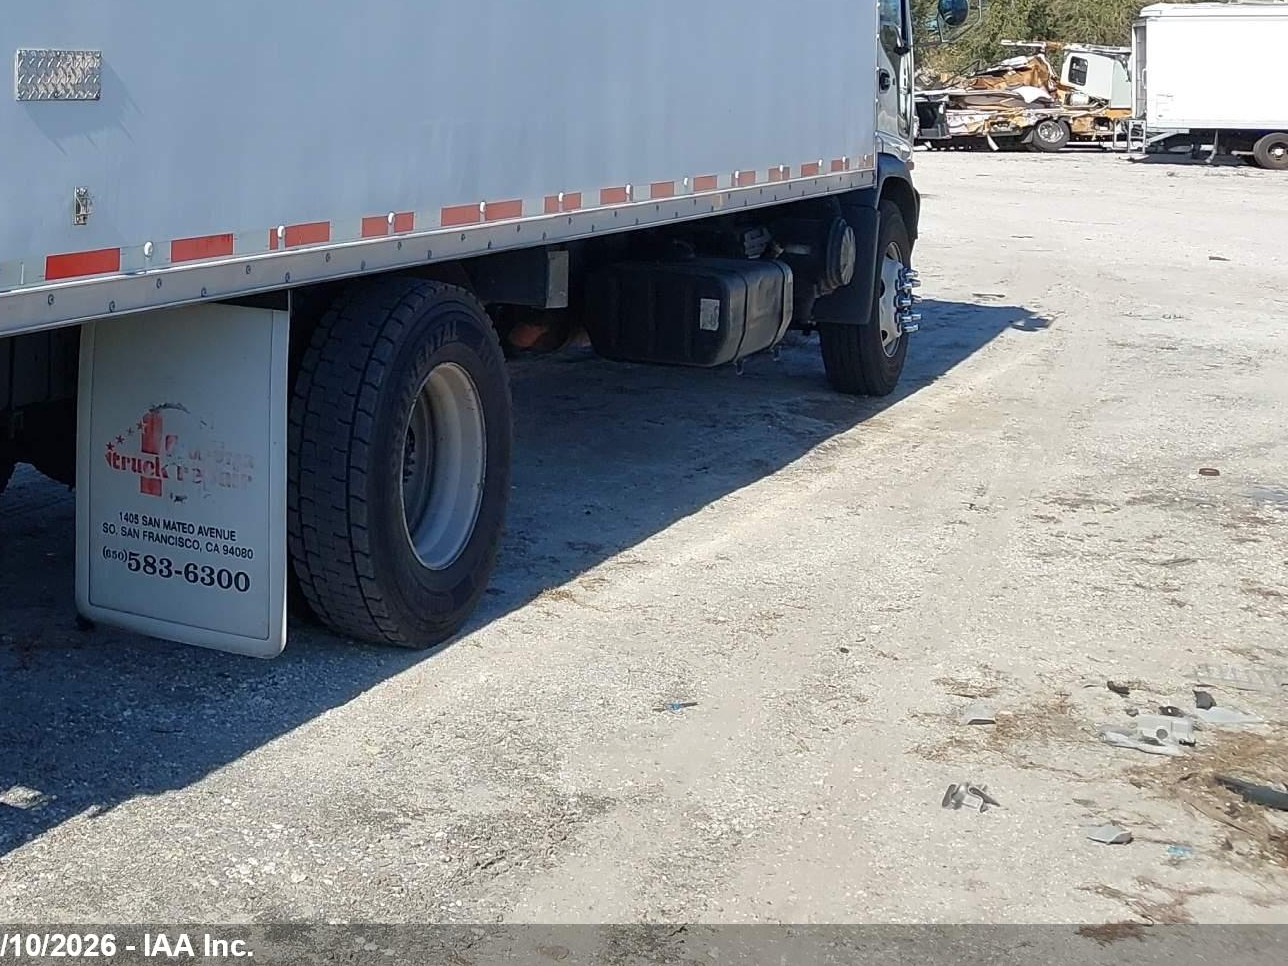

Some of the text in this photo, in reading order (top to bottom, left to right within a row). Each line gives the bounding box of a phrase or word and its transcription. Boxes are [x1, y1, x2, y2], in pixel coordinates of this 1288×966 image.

[102, 522, 254, 559] SO. SAN FRANCISCO, CA 94080
[119, 512, 237, 541] 1405 SAN MATEO AVENUE
